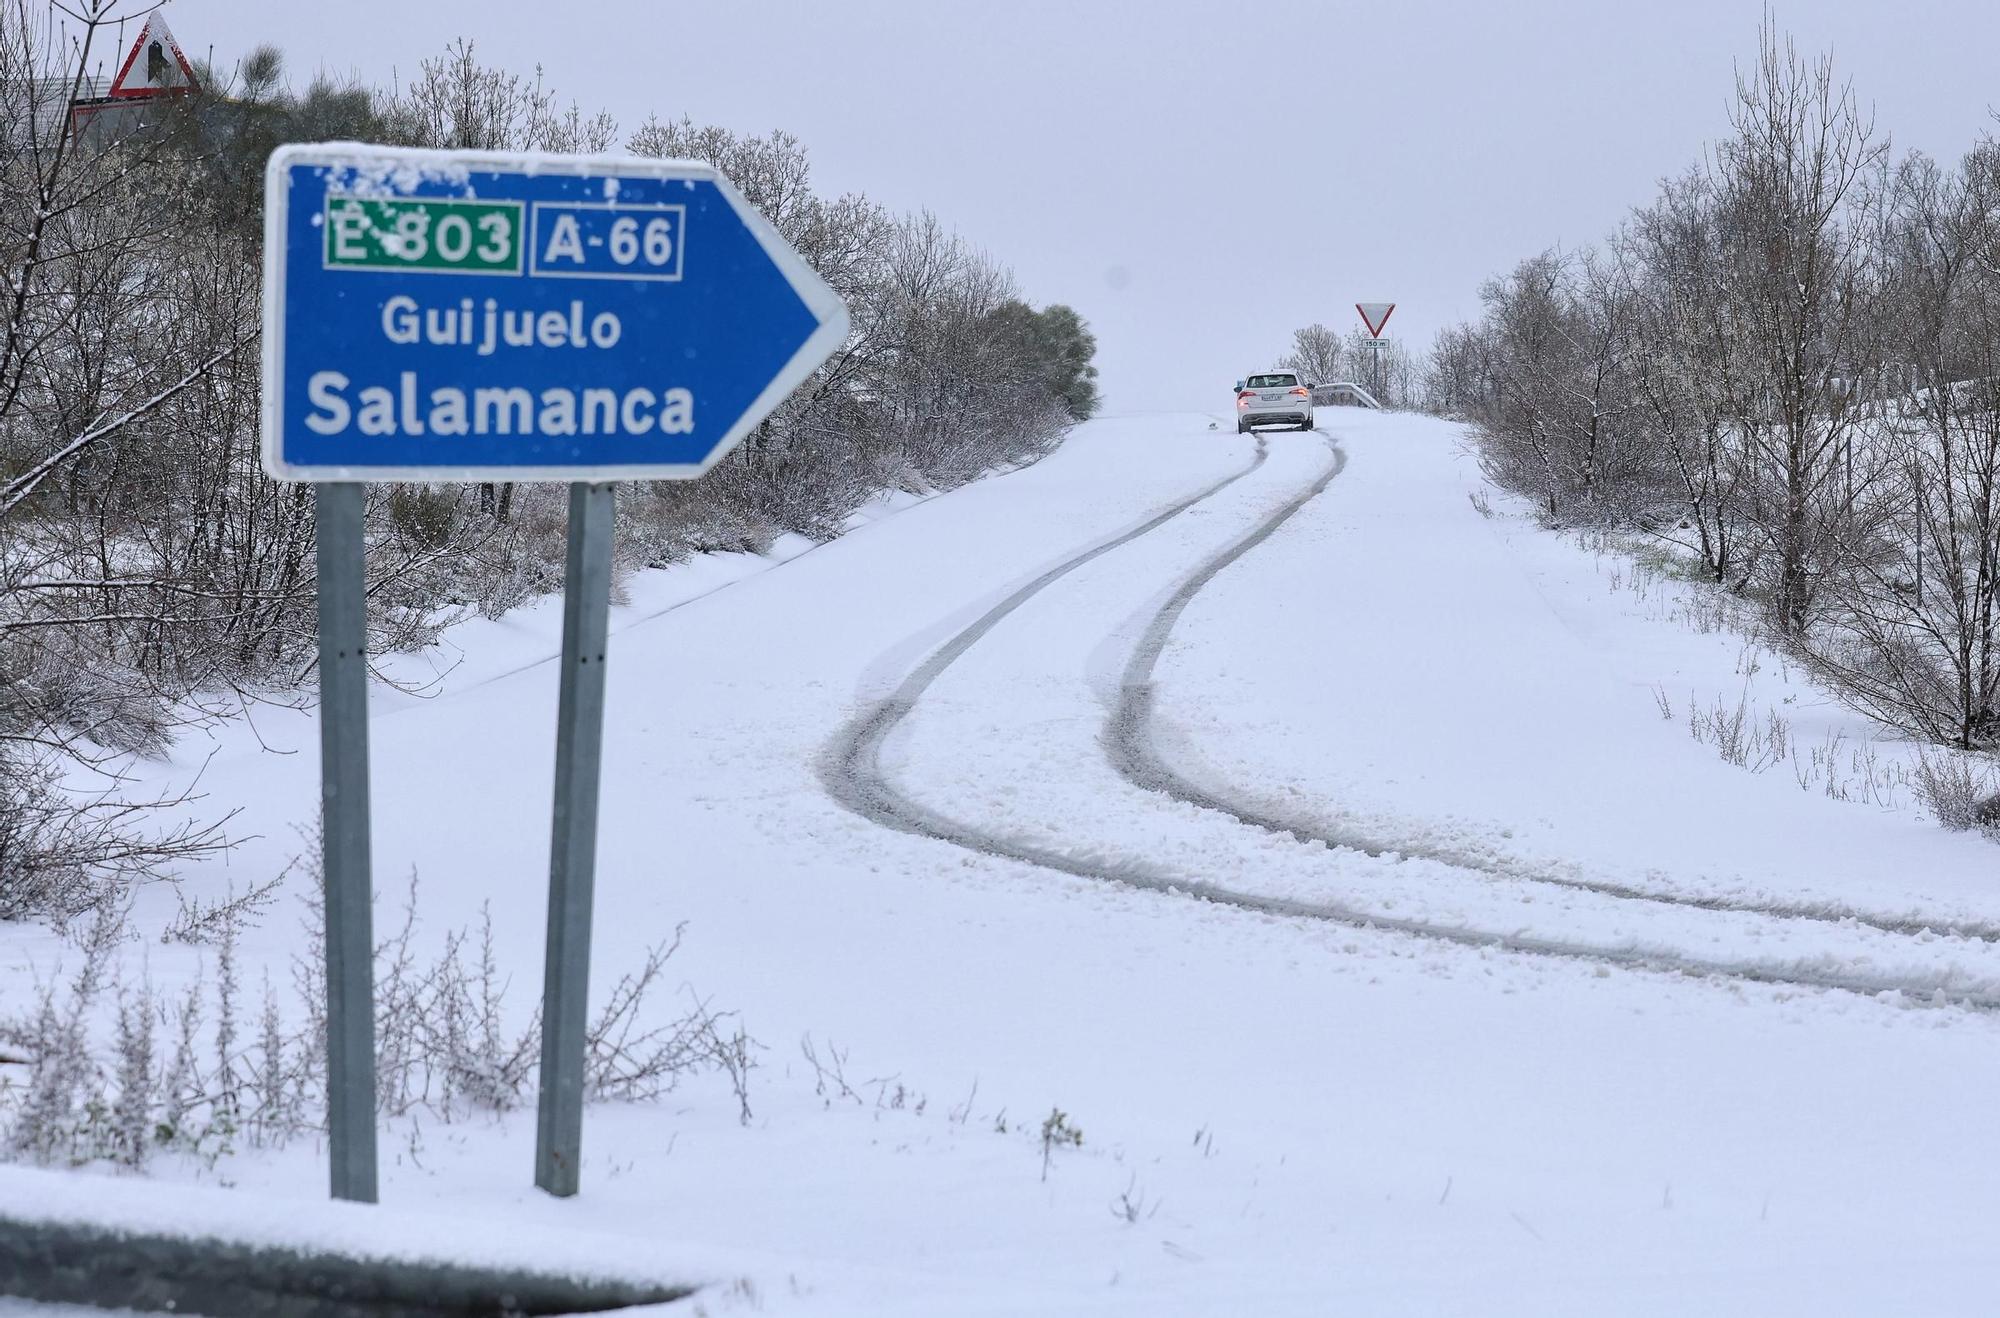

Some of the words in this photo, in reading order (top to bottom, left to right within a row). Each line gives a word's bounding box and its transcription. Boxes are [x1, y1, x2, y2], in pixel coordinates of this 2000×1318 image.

[544, 215, 672, 266] A-66
[381, 296, 622, 356] Guijuelo
[304, 371, 695, 436] Salamanca
